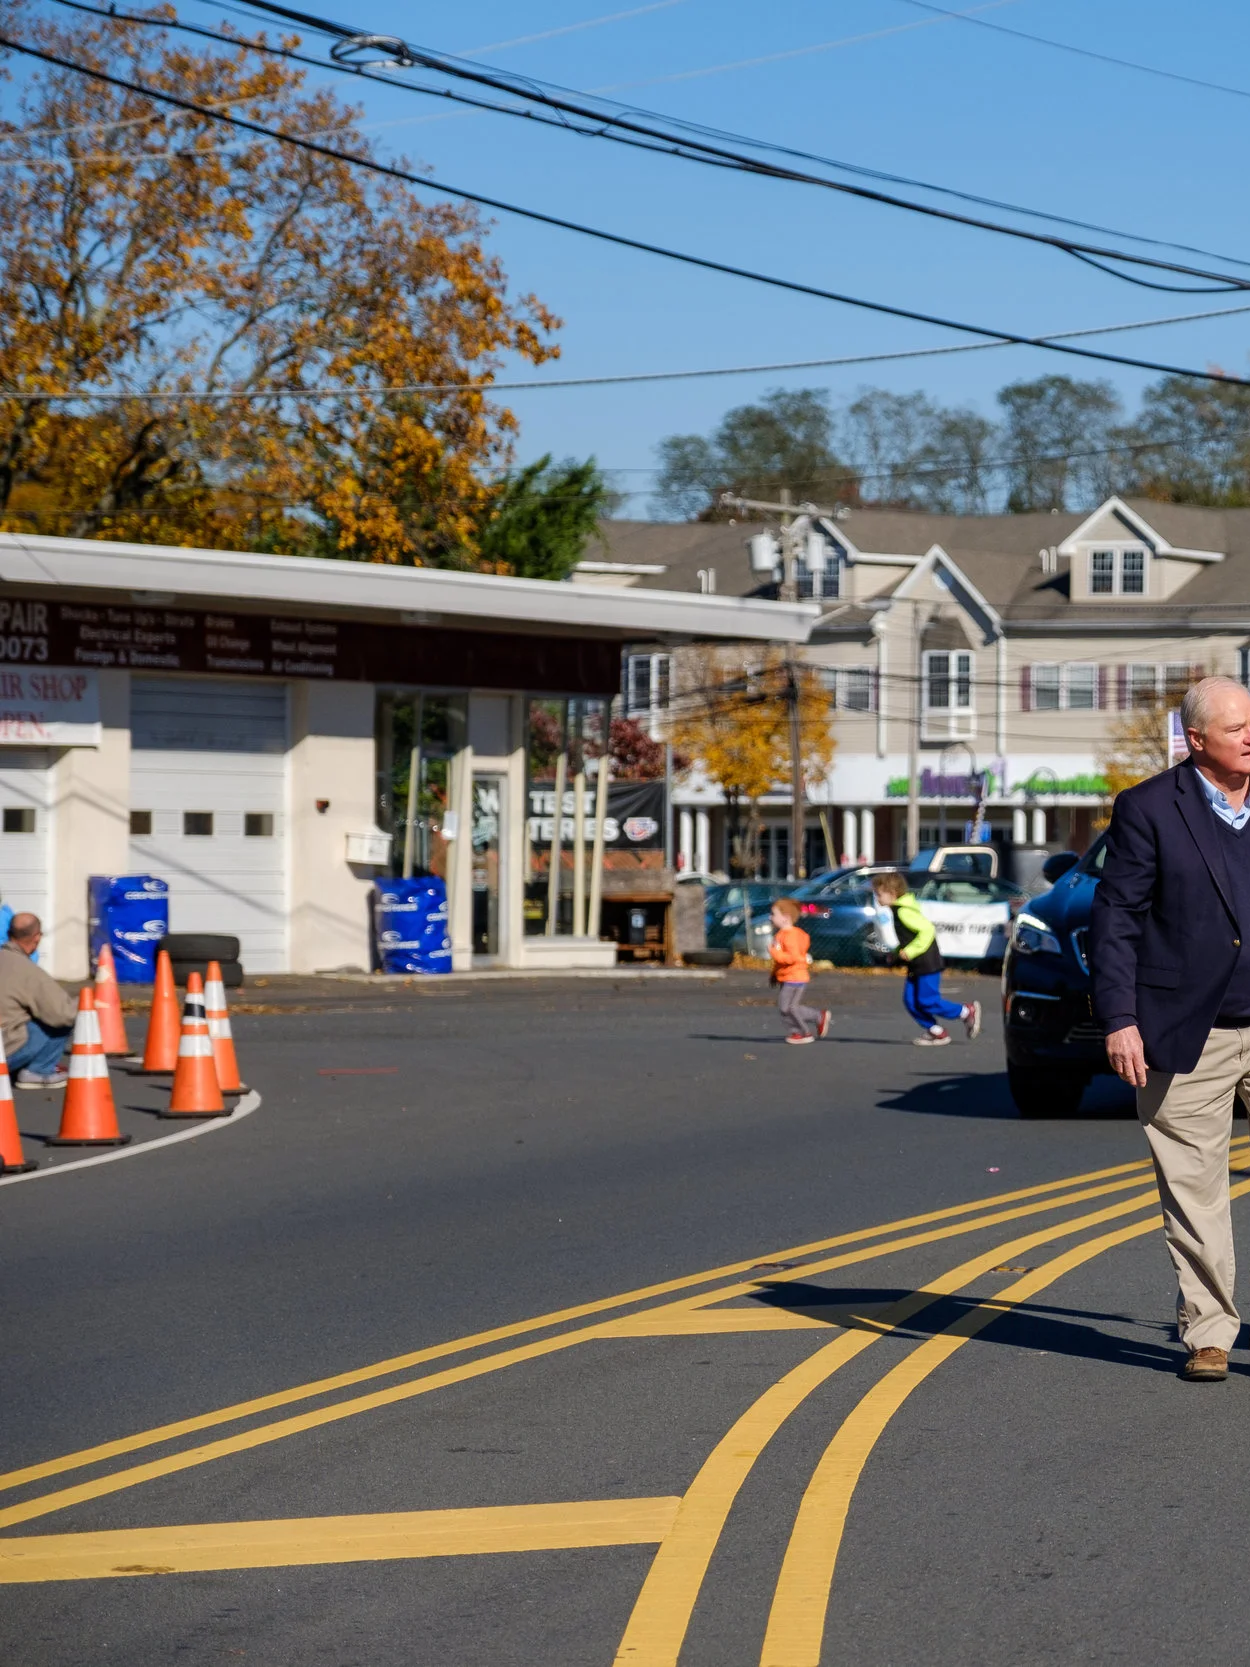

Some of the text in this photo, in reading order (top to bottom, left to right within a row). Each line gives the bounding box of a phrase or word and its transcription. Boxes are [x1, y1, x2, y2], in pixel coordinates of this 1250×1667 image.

[0, 671, 87, 703] IR SHOP
[528, 790, 597, 815] TEST
